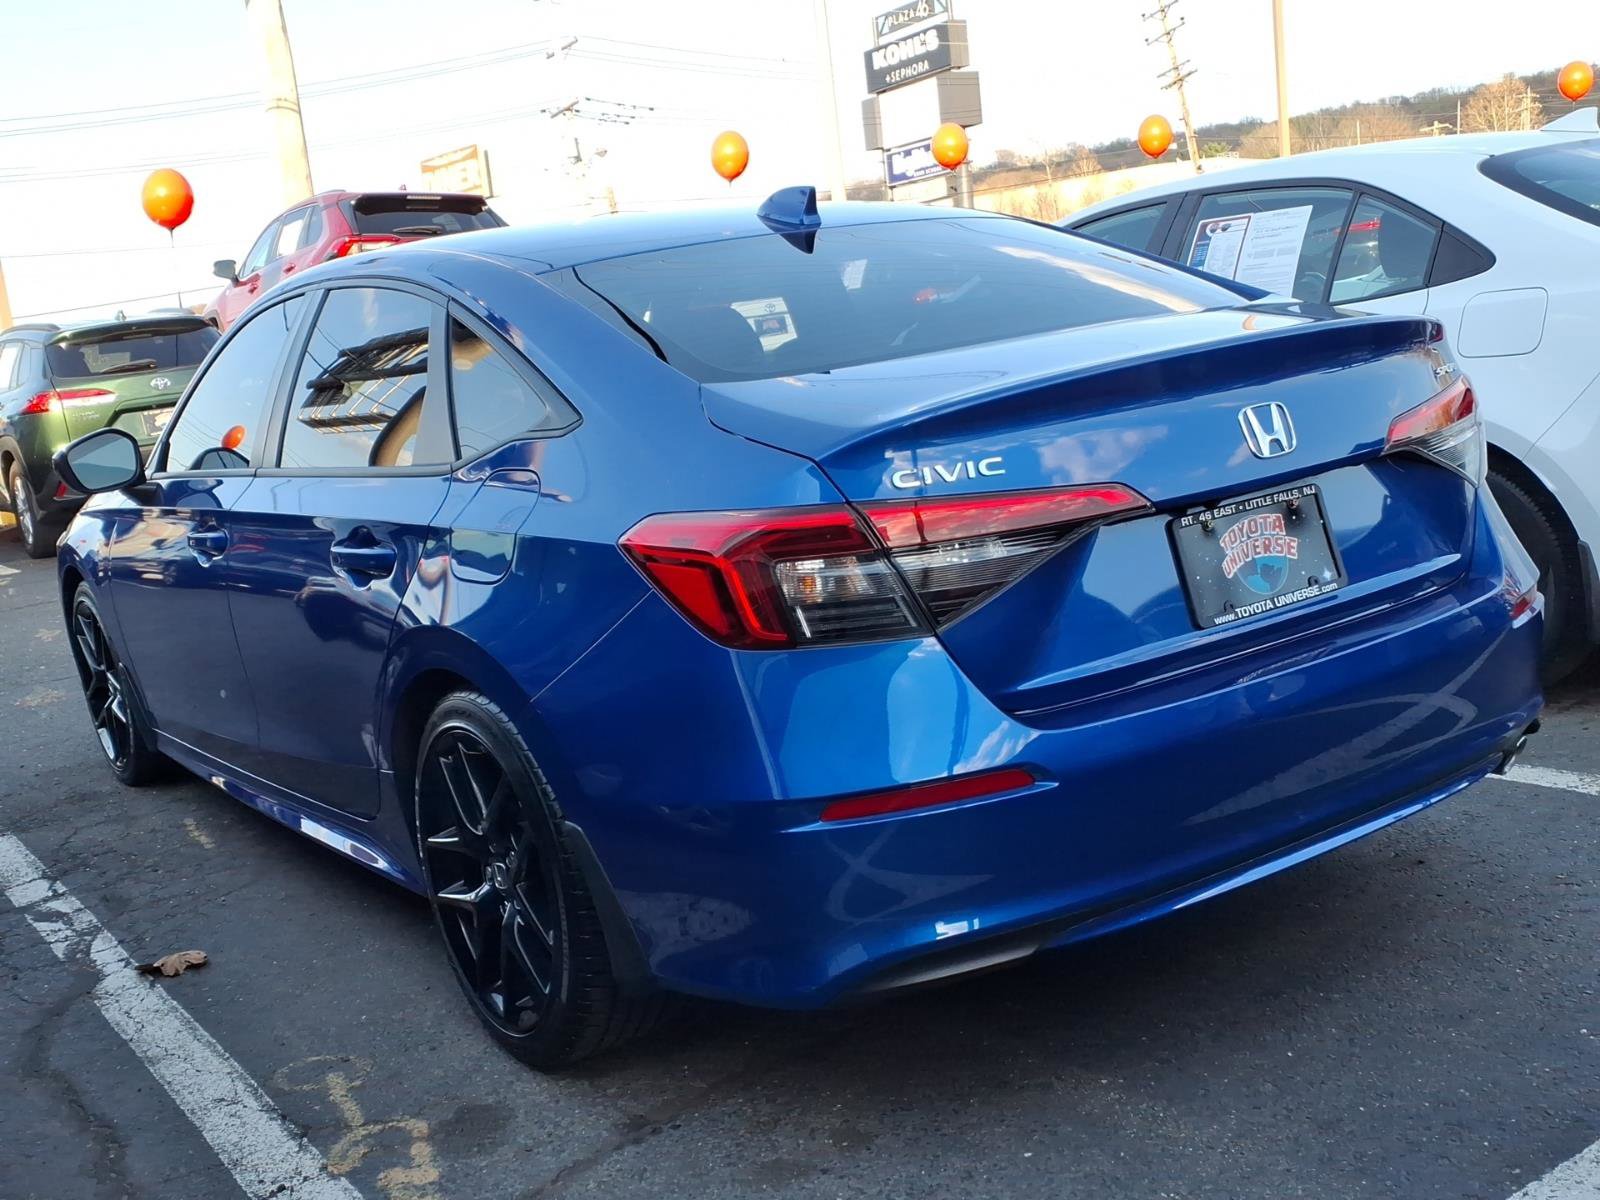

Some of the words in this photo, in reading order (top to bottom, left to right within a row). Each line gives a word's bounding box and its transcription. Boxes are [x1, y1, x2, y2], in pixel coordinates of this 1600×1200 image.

[888, 8, 914, 27] PLAZA
[915, 0, 929, 18] 46
[872, 28, 940, 71] KOHL'S
[891, 456, 1006, 489] CIVIC
[1181, 515, 1197, 527] RT.
[1198, 511, 1212, 522] 46
[1213, 504, 1237, 518] EAST
[1245, 495, 1273, 510] LITTLE
[1303, 485, 1316, 496] NJ
[1219, 513, 1287, 554] TOYOTA
[1221, 535, 1299, 579] UNIVERSE
